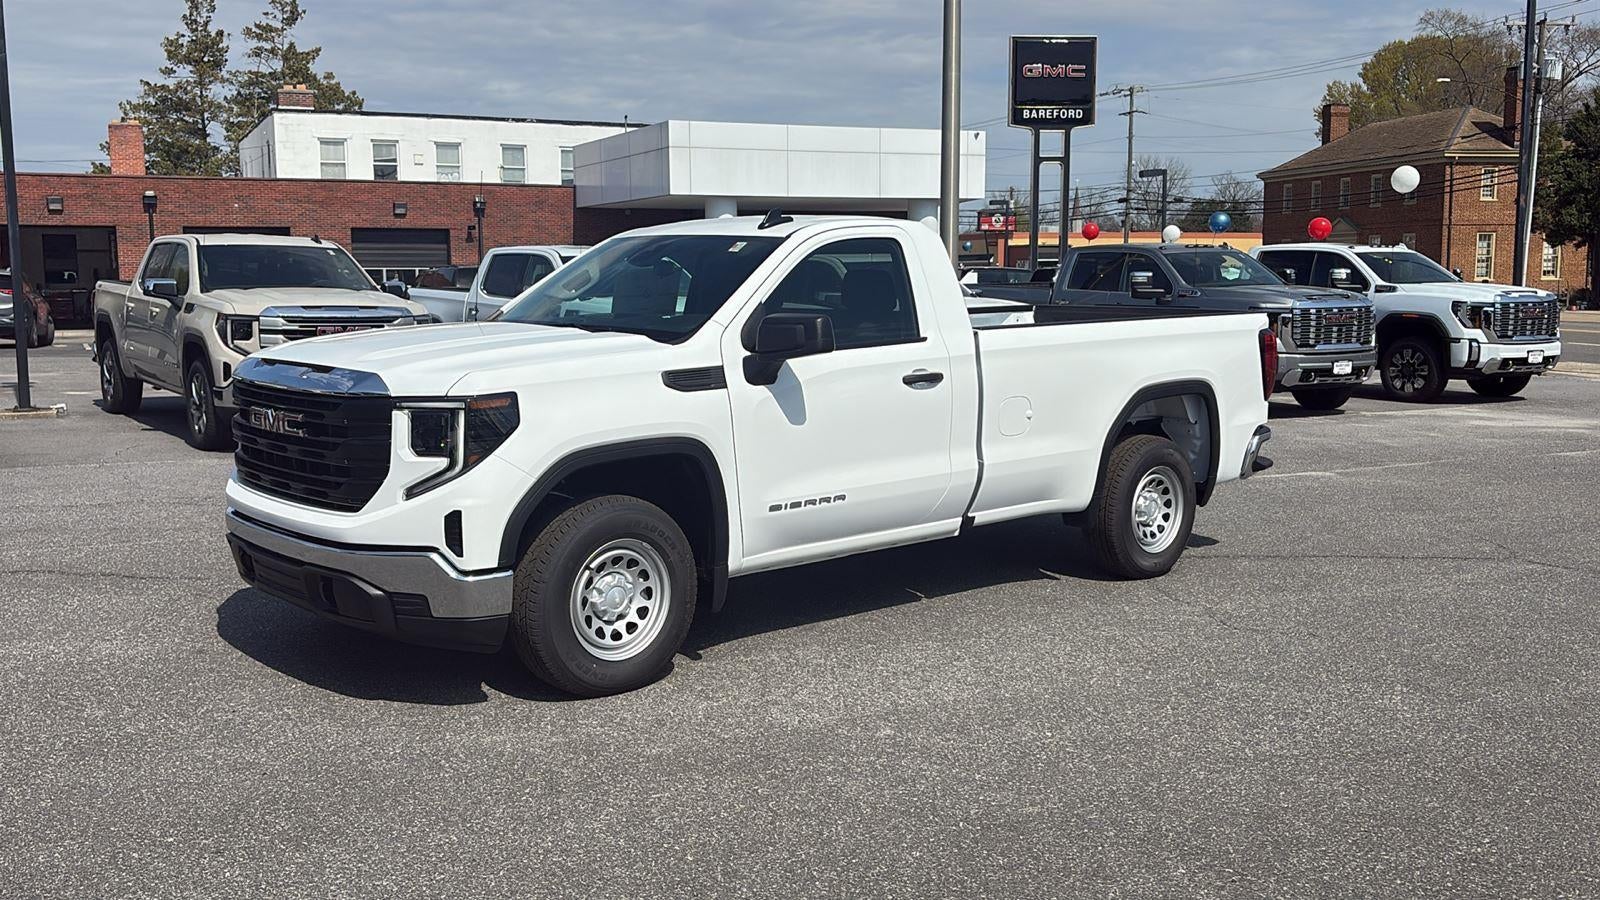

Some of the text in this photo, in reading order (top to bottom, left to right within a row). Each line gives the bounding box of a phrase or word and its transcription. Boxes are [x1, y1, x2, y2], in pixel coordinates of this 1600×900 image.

[1023, 64, 1086, 77] GMC
[1023, 109, 1083, 119] BAREFORD
[250, 406, 305, 437] GMC
[768, 494, 846, 512] SIERRA
